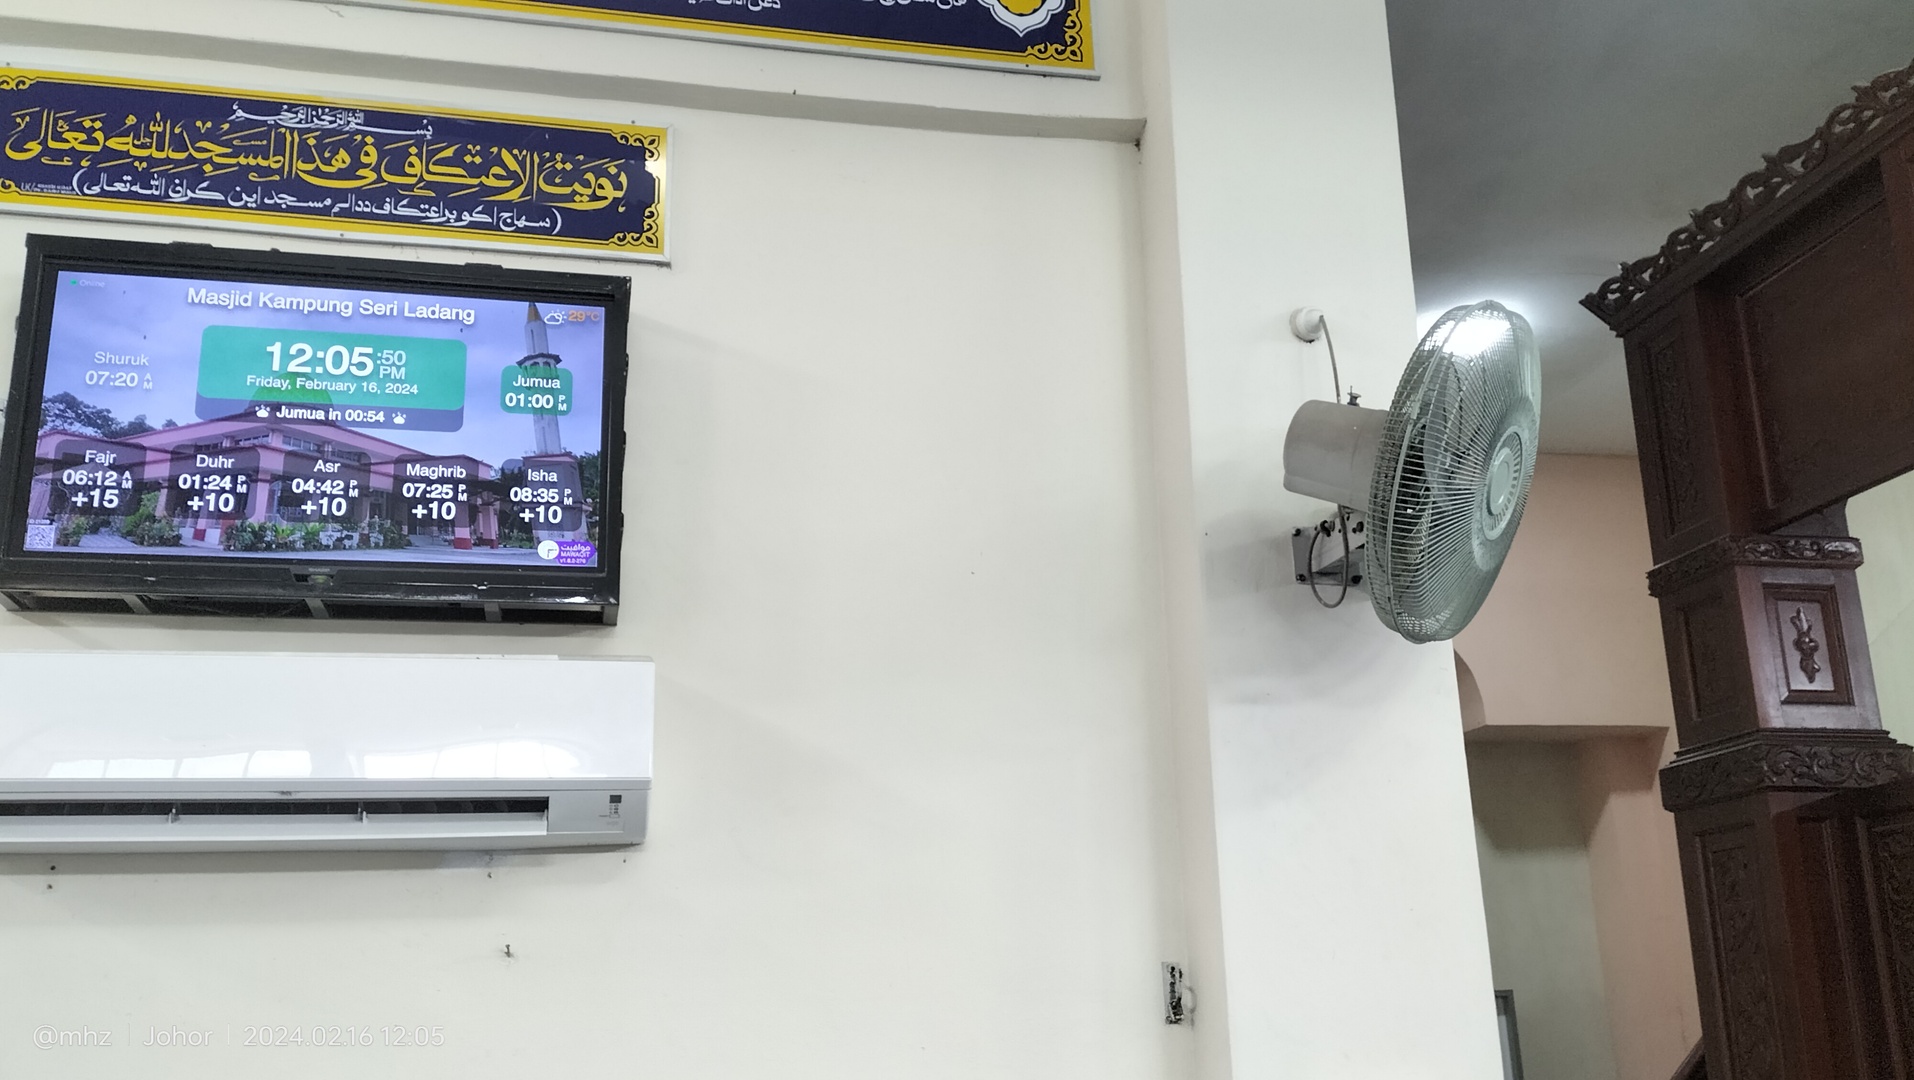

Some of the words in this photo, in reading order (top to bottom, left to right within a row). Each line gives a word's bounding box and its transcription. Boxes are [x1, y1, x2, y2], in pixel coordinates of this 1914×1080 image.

[187, 286, 253, 310] Masjid
[258, 291, 354, 318] Kampung
[359, 298, 399, 317] Seri
[403, 301, 476, 326] Ladang
[93, 350, 150, 366] Shuruk
[266, 341, 375, 377] 12:05
[85, 370, 139, 387] 07:20
[379, 366, 407, 380] PM
[512, 374, 562, 389] Jumua
[246, 374, 292, 391] Friday,
[295, 376, 357, 395] February
[361, 381, 381, 395] 16,
[385, 382, 419, 395] 2024
[504, 392, 554, 409] 01:00
[276, 405, 326, 421] Jumua
[328, 406, 342, 421] in
[347, 409, 386, 423] 00:54
[84, 449, 117, 467] Fajr
[195, 454, 235, 469] Duhr
[313, 459, 341, 473] Asr
[62, 469, 118, 487] 06:12
[406, 463, 467, 480] Maghrib
[527, 468, 558, 482] Isha
[178, 473, 233, 491] 01:24
[291, 478, 345, 495] 04:42
[402, 482, 454, 499] 07:25
[71, 488, 120, 509] +15
[187, 492, 235, 513] +10
[509, 486, 559, 503] 08:35
[300, 497, 347, 517] +10
[411, 500, 456, 521] +10
[519, 505, 563, 524] +10
